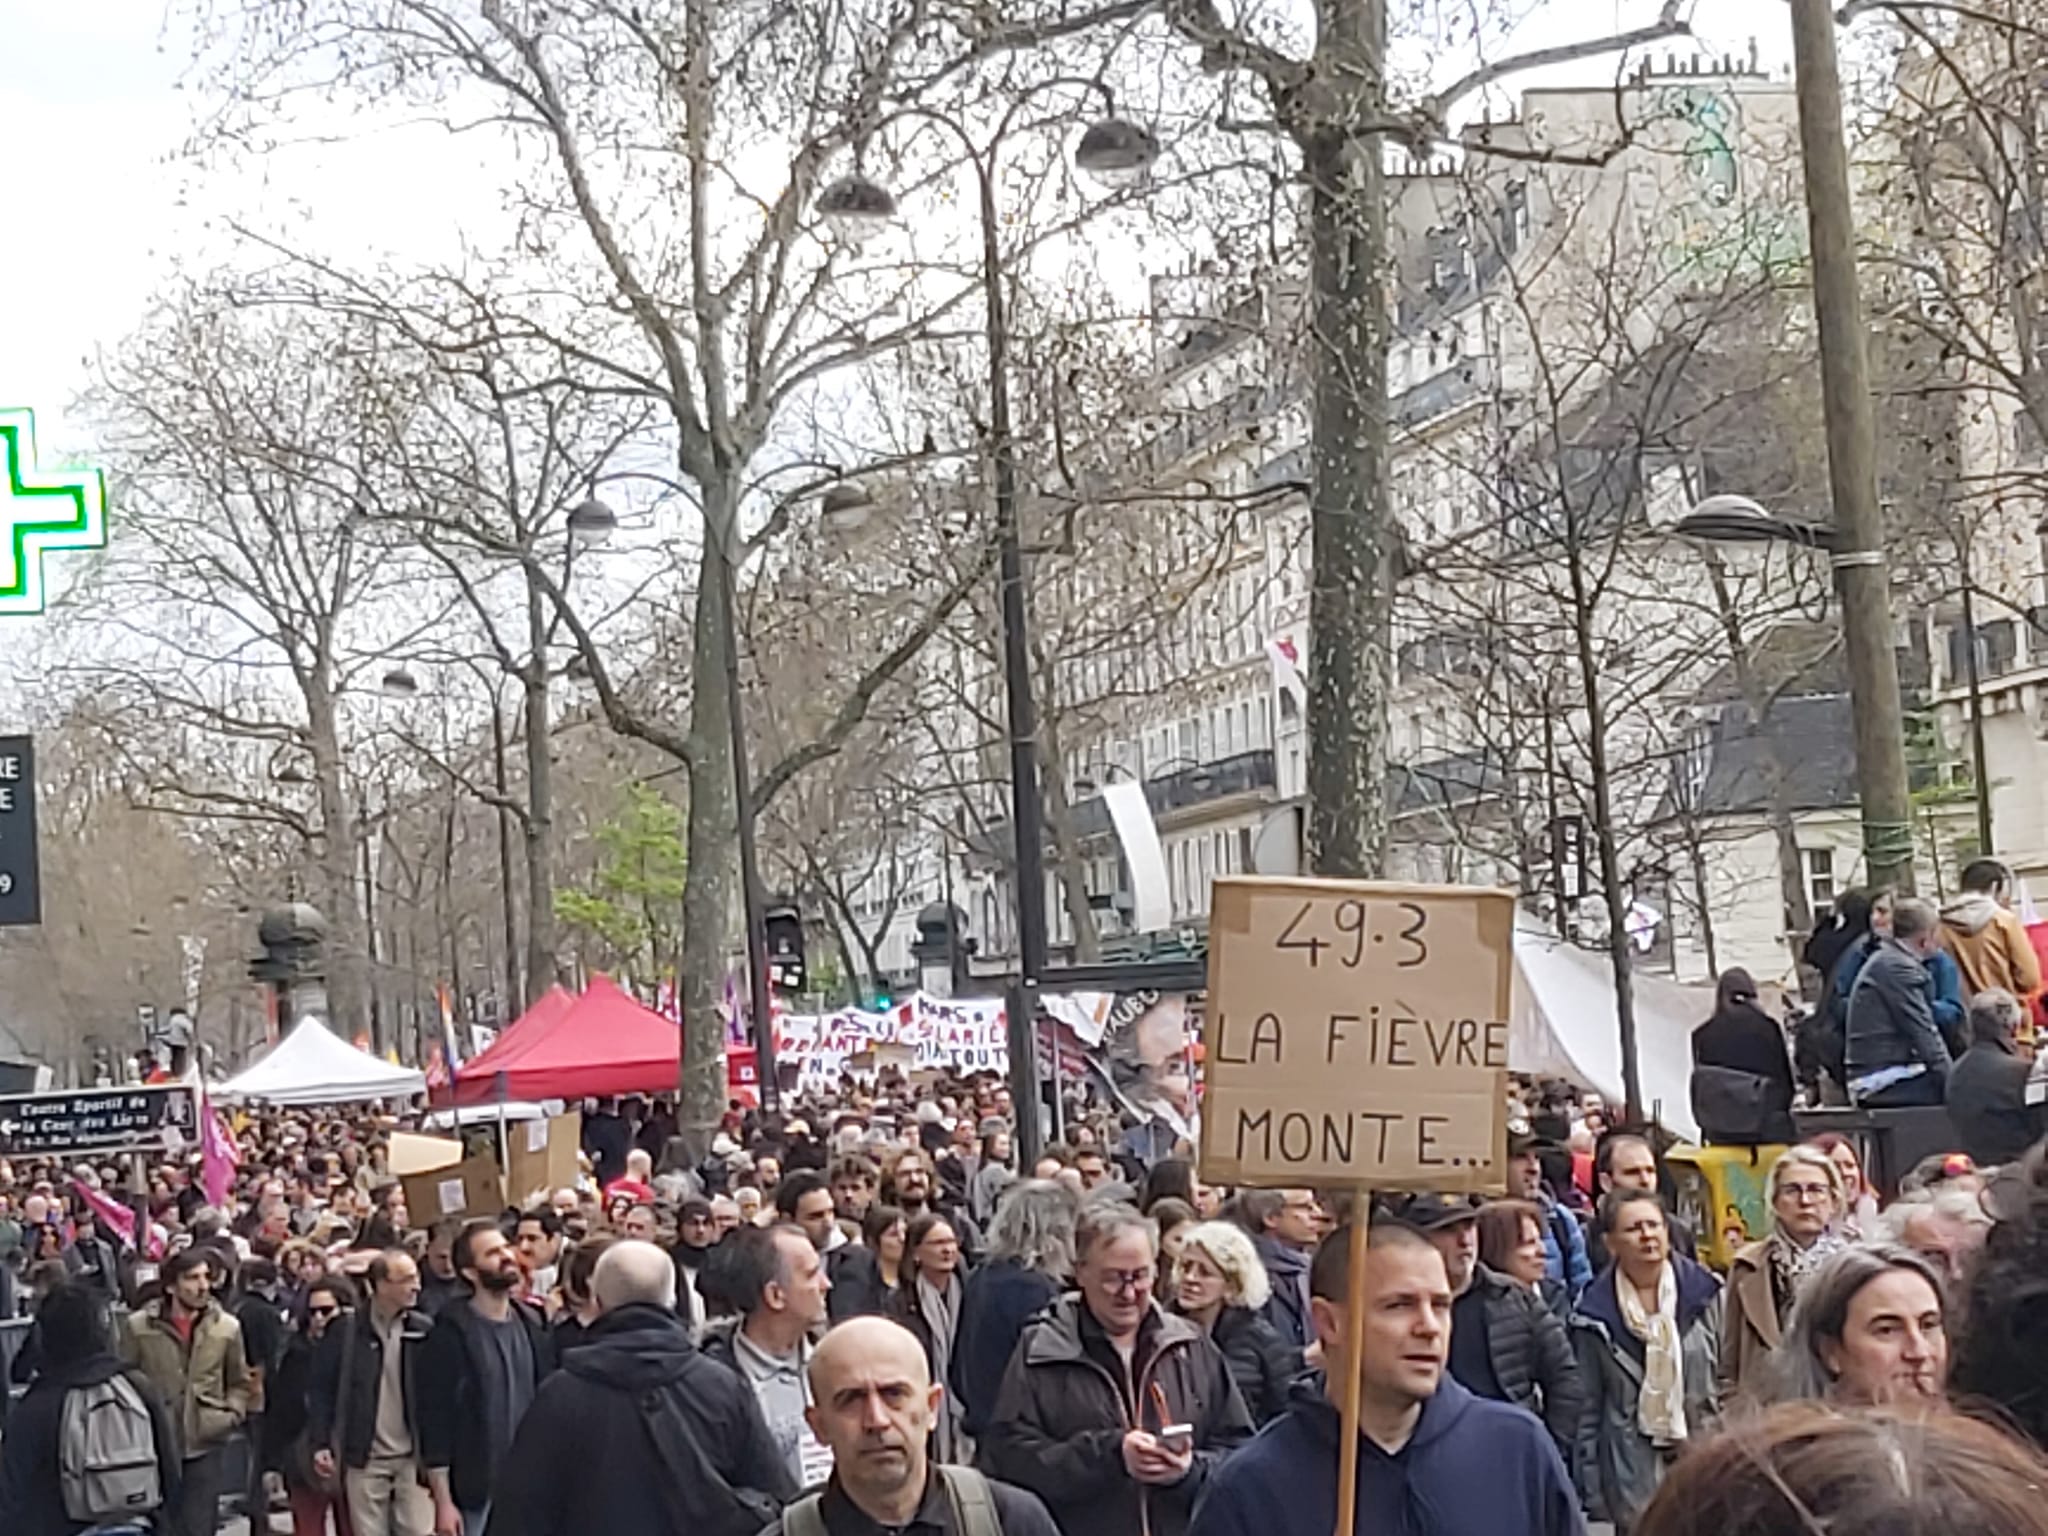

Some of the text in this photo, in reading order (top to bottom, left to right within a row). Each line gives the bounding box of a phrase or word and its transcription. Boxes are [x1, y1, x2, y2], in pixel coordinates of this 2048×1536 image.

[1275, 898, 1429, 969] 49.3
[1217, 1012, 1282, 1065] LA
[73, 1097, 124, 1115] Sportif
[129, 1096, 147, 1109] de
